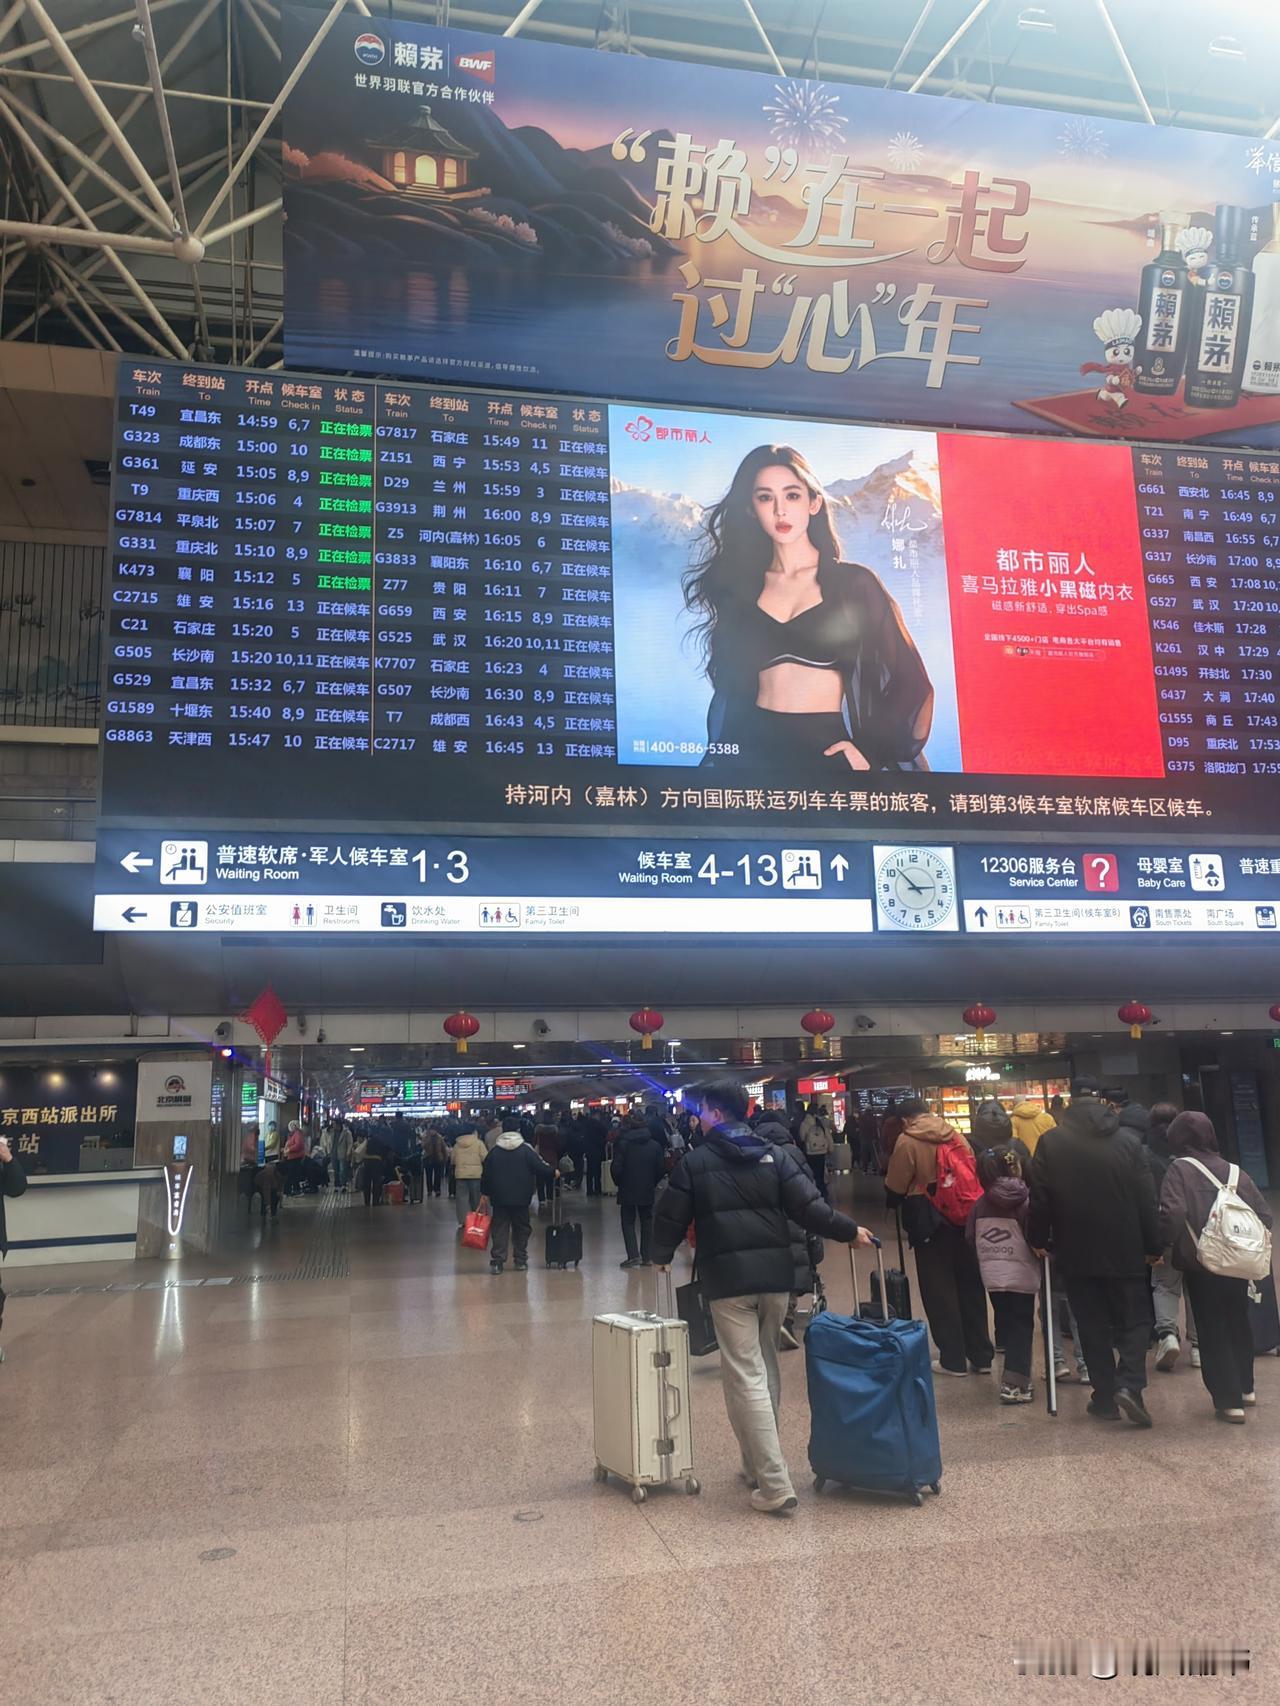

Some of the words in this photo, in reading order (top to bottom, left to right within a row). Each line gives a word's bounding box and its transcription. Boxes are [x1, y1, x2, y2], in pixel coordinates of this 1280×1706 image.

[459, 57, 492, 71] BWF
[354, 73, 495, 104] 世界羽联官方合作伙伴
[133, 370, 161, 383] 车次
[183, 374, 225, 390] 终到站
[246, 380, 272, 394] 开点
[282, 384, 322, 398] 候车室
[130, 404, 155, 416] T49
[180, 409, 221, 424] 宜昌东
[239, 415, 277, 428] 14:59
[289, 419, 310, 431] 6,7
[320, 420, 372, 438] 正在检票
[376, 427, 417, 439] G7817
[431, 430, 468, 444] 石家庄
[484, 435, 519, 447] 15:49
[655, 427, 711, 444] 都市丽人
[123, 430, 159, 443] G323
[179, 435, 220, 450] 成都东
[238, 440, 277, 454] 15:00
[320, 446, 372, 462] 正在检票
[123, 456, 158, 469] G361
[237, 466, 276, 479] 15:05
[380, 451, 412, 464] Z151
[484, 459, 520, 472] 15:53
[383, 476, 410, 488] D29
[484, 484, 520, 496] 15:59
[1138, 484, 1165, 494] G661
[1178, 486, 1210, 498] 西安北
[131, 484, 149, 495] T9
[177, 487, 220, 503] 重庆西
[236, 492, 276, 505] 15:06
[375, 502, 417, 514] G3913
[1144, 506, 1164, 516] T21
[116, 510, 161, 523] G7814
[177, 514, 219, 528] 平泉北
[236, 518, 275, 531] 15:07
[387, 528, 404, 539] Z5
[419, 529, 480, 545] 河内(嘉林)
[484, 534, 521, 547] 16:05
[1143, 528, 1169, 539] G337
[1183, 530, 1214, 543] 南昌西
[119, 537, 156, 550] G331
[176, 540, 218, 555] 重庆北
[235, 544, 275, 557] 15:10
[375, 553, 417, 566] G3833
[431, 555, 469, 570] 襄阳东
[485, 559, 521, 571] 16:10
[996, 548, 1095, 576] 都市丽人
[1145, 551, 1172, 562] G317
[1186, 553, 1217, 566] 长沙南
[119, 563, 154, 576] K473
[234, 570, 274, 584] 15:12
[1148, 574, 1175, 584] G665
[383, 579, 408, 591] Z77
[961, 575, 1135, 601] 喜马拉雅小黑磁内衣
[113, 591, 158, 603] C2715
[233, 597, 273, 610] 15:16
[1150, 597, 1177, 607] G527
[378, 605, 412, 617] G659
[121, 619, 148, 630] C21
[174, 621, 215, 635] 石家庄
[233, 624, 273, 637] 15:20
[1153, 620, 1179, 630] K546
[1193, 622, 1225, 633] 佳木斯
[378, 631, 412, 643] G525
[1155, 643, 1182, 653] K261
[114, 646, 152, 658] G505
[172, 648, 214, 663] 长沙南
[231, 651, 272, 665] 15:20
[374, 657, 416, 670] K7707
[431, 660, 469, 673] 石家庄
[1154, 666, 1188, 677] G1495
[1198, 667, 1230, 680] 开封北
[113, 673, 151, 685] G529
[171, 676, 213, 690] 宜昌东
[231, 679, 271, 691] 15:32
[377, 685, 412, 696] G507
[431, 686, 469, 700] 长沙南
[1160, 690, 1186, 700] 6437
[107, 701, 154, 714] G1589
[170, 704, 212, 718] 十堰东
[230, 706, 271, 719] 15:40
[386, 711, 403, 723] T7
[431, 712, 470, 726] 成都西
[1159, 713, 1193, 724] G1555
[106, 729, 153, 742] G8863
[169, 732, 212, 746] 天津西
[229, 733, 270, 746] 15:47
[314, 736, 369, 751] 正在候车
[374, 738, 416, 751] C2717
[1168, 737, 1190, 747] D95
[1206, 738, 1239, 750] 重庆北
[651, 741, 739, 755] 400-886-5388
[1167, 761, 1195, 771] G375
[1204, 761, 1247, 774] 洛阳龙门
[897, 858, 903, 867] 11
[909, 855, 918, 863] 12
[637, 851, 692, 870] 候车室
[698, 854, 778, 886] 4-13
[980, 857, 1076, 875] 12306服务台
[1137, 858, 1184, 874] 母婴室
[216, 868, 260, 881] Waiting
[263, 868, 299, 880] Room
[619, 872, 658, 885] Waiting
[661, 873, 693, 884] Room
[886, 869, 896, 877] 10
[936, 870, 943, 878] 2
[883, 884, 889, 892] 9
[941, 885, 948, 893] 3
[1009, 877, 1043, 887] Service
[1046, 877, 1078, 888] Center
[1138, 878, 1160, 890] Baby
[1162, 878, 1186, 889] Care
[889, 899, 895, 907] 8
[938, 899, 944, 907] 4
[205, 904, 267, 916] 公安值班室
[323, 905, 358, 917] 卫生间
[411, 905, 446, 917] 饮水处
[525, 905, 580, 917] 第三卫生间
[901, 910, 907, 918] 7
[928, 910, 934, 918] 5
[1207, 908, 1234, 918] 南广场
[205, 917, 235, 926] Security
[323, 918, 360, 926] Restrooms
[411, 918, 439, 927] Drinking
[914, 915, 921, 923] 6
[1, 1105, 118, 1126] 京西站派出所
